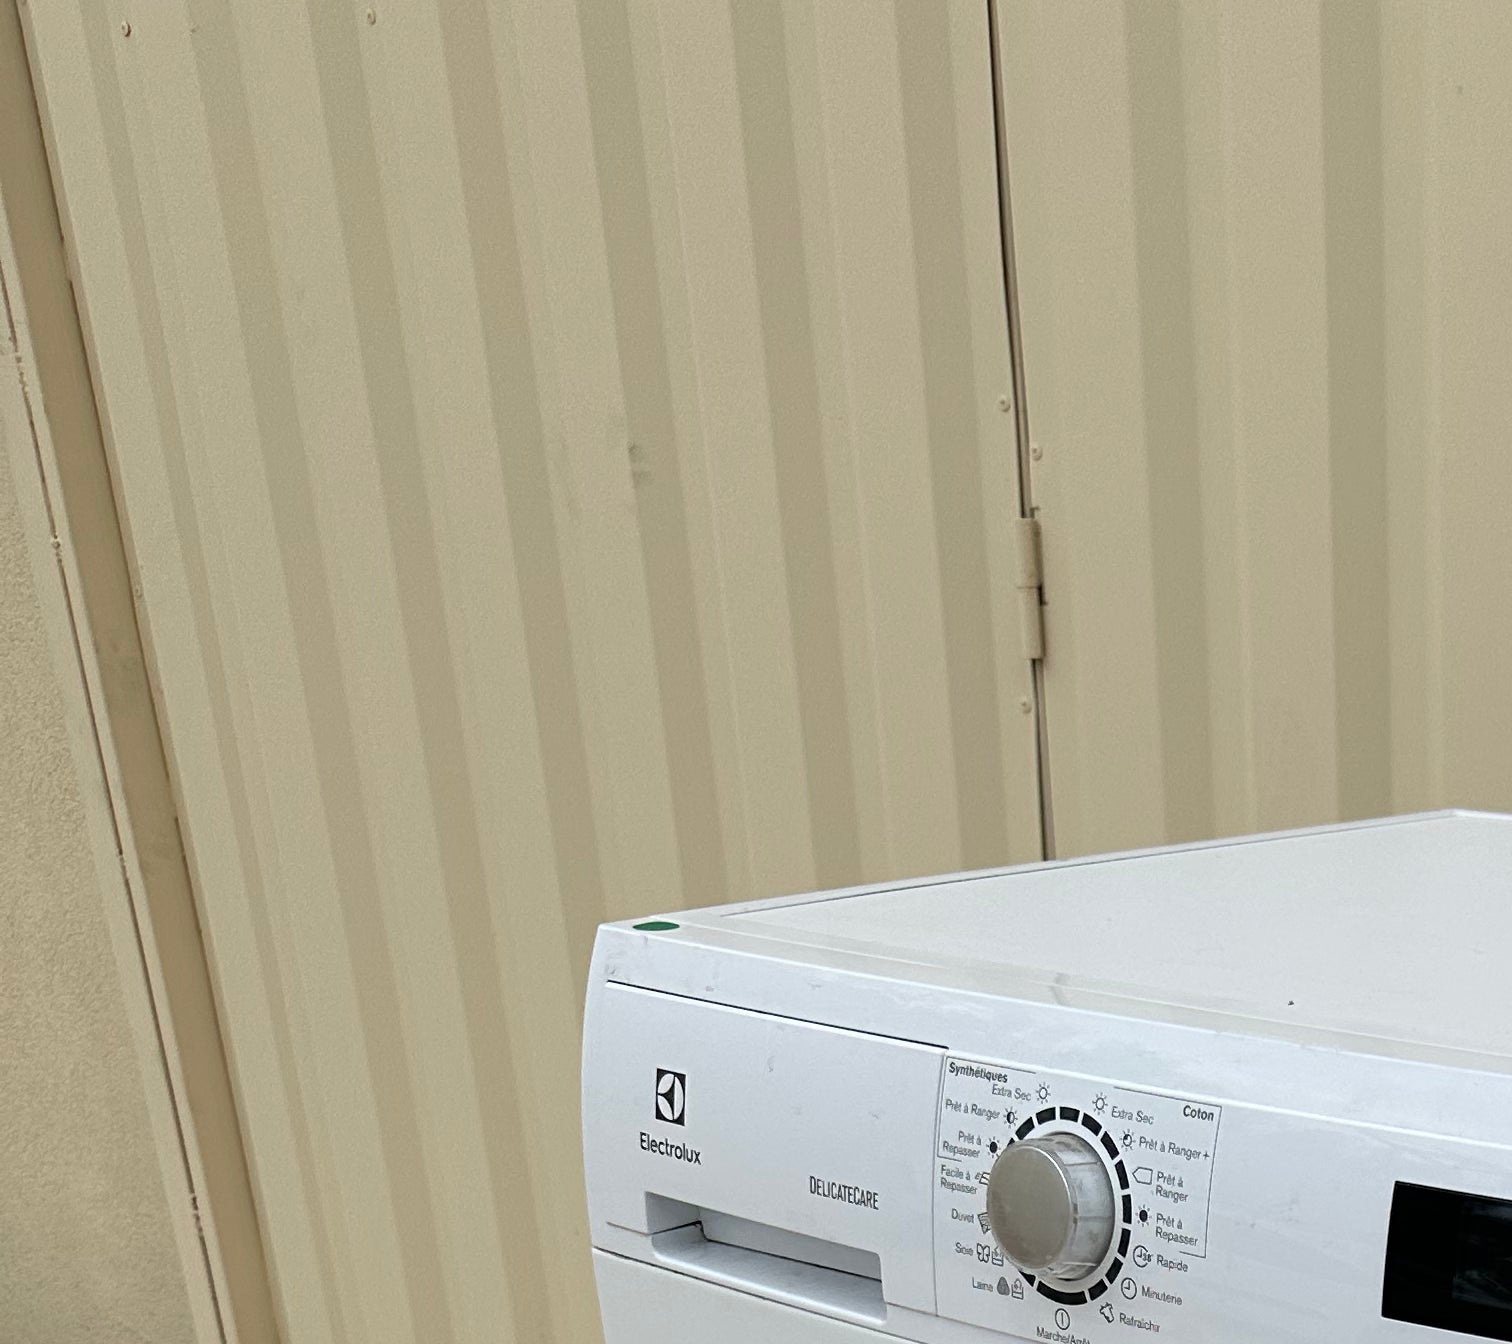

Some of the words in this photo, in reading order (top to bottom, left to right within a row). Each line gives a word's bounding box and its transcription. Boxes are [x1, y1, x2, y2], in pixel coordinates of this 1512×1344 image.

[949, 1062, 1008, 1083] Synthétiques
[992, 1084, 1012, 1098] Extra
[1015, 1088, 1031, 1101] Sec
[971, 1104, 1000, 1121] Ranger
[1111, 1106, 1133, 1120] Extra
[1136, 1111, 1154, 1125] Sec
[1183, 1105, 1214, 1121] Coton
[640, 1132, 701, 1165] Electrolux
[943, 1141, 980, 1159] Repasser
[1139, 1136, 1157, 1150] Prêt
[1160, 1141, 1165, 1153] à
[1168, 1142, 1201, 1161] Ranger
[941, 1165, 964, 1176] Facile
[966, 1169, 971, 1180] à
[1157, 1171, 1175, 1186] Prêt
[1178, 1177, 1183, 1187] à
[809, 1175, 879, 1210] DELICATECARE
[941, 1178, 978, 1195] Repasser
[1156, 1185, 1188, 1203] Ranger
[951, 1208, 975, 1224] Duvet
[1156, 1213, 1174, 1229] Prêt
[1177, 1218, 1183, 1230] à
[1156, 1226, 1198, 1246] Repasser
[1157, 1254, 1189, 1272] Rapide
[1141, 1285, 1183, 1305] Minuterie
